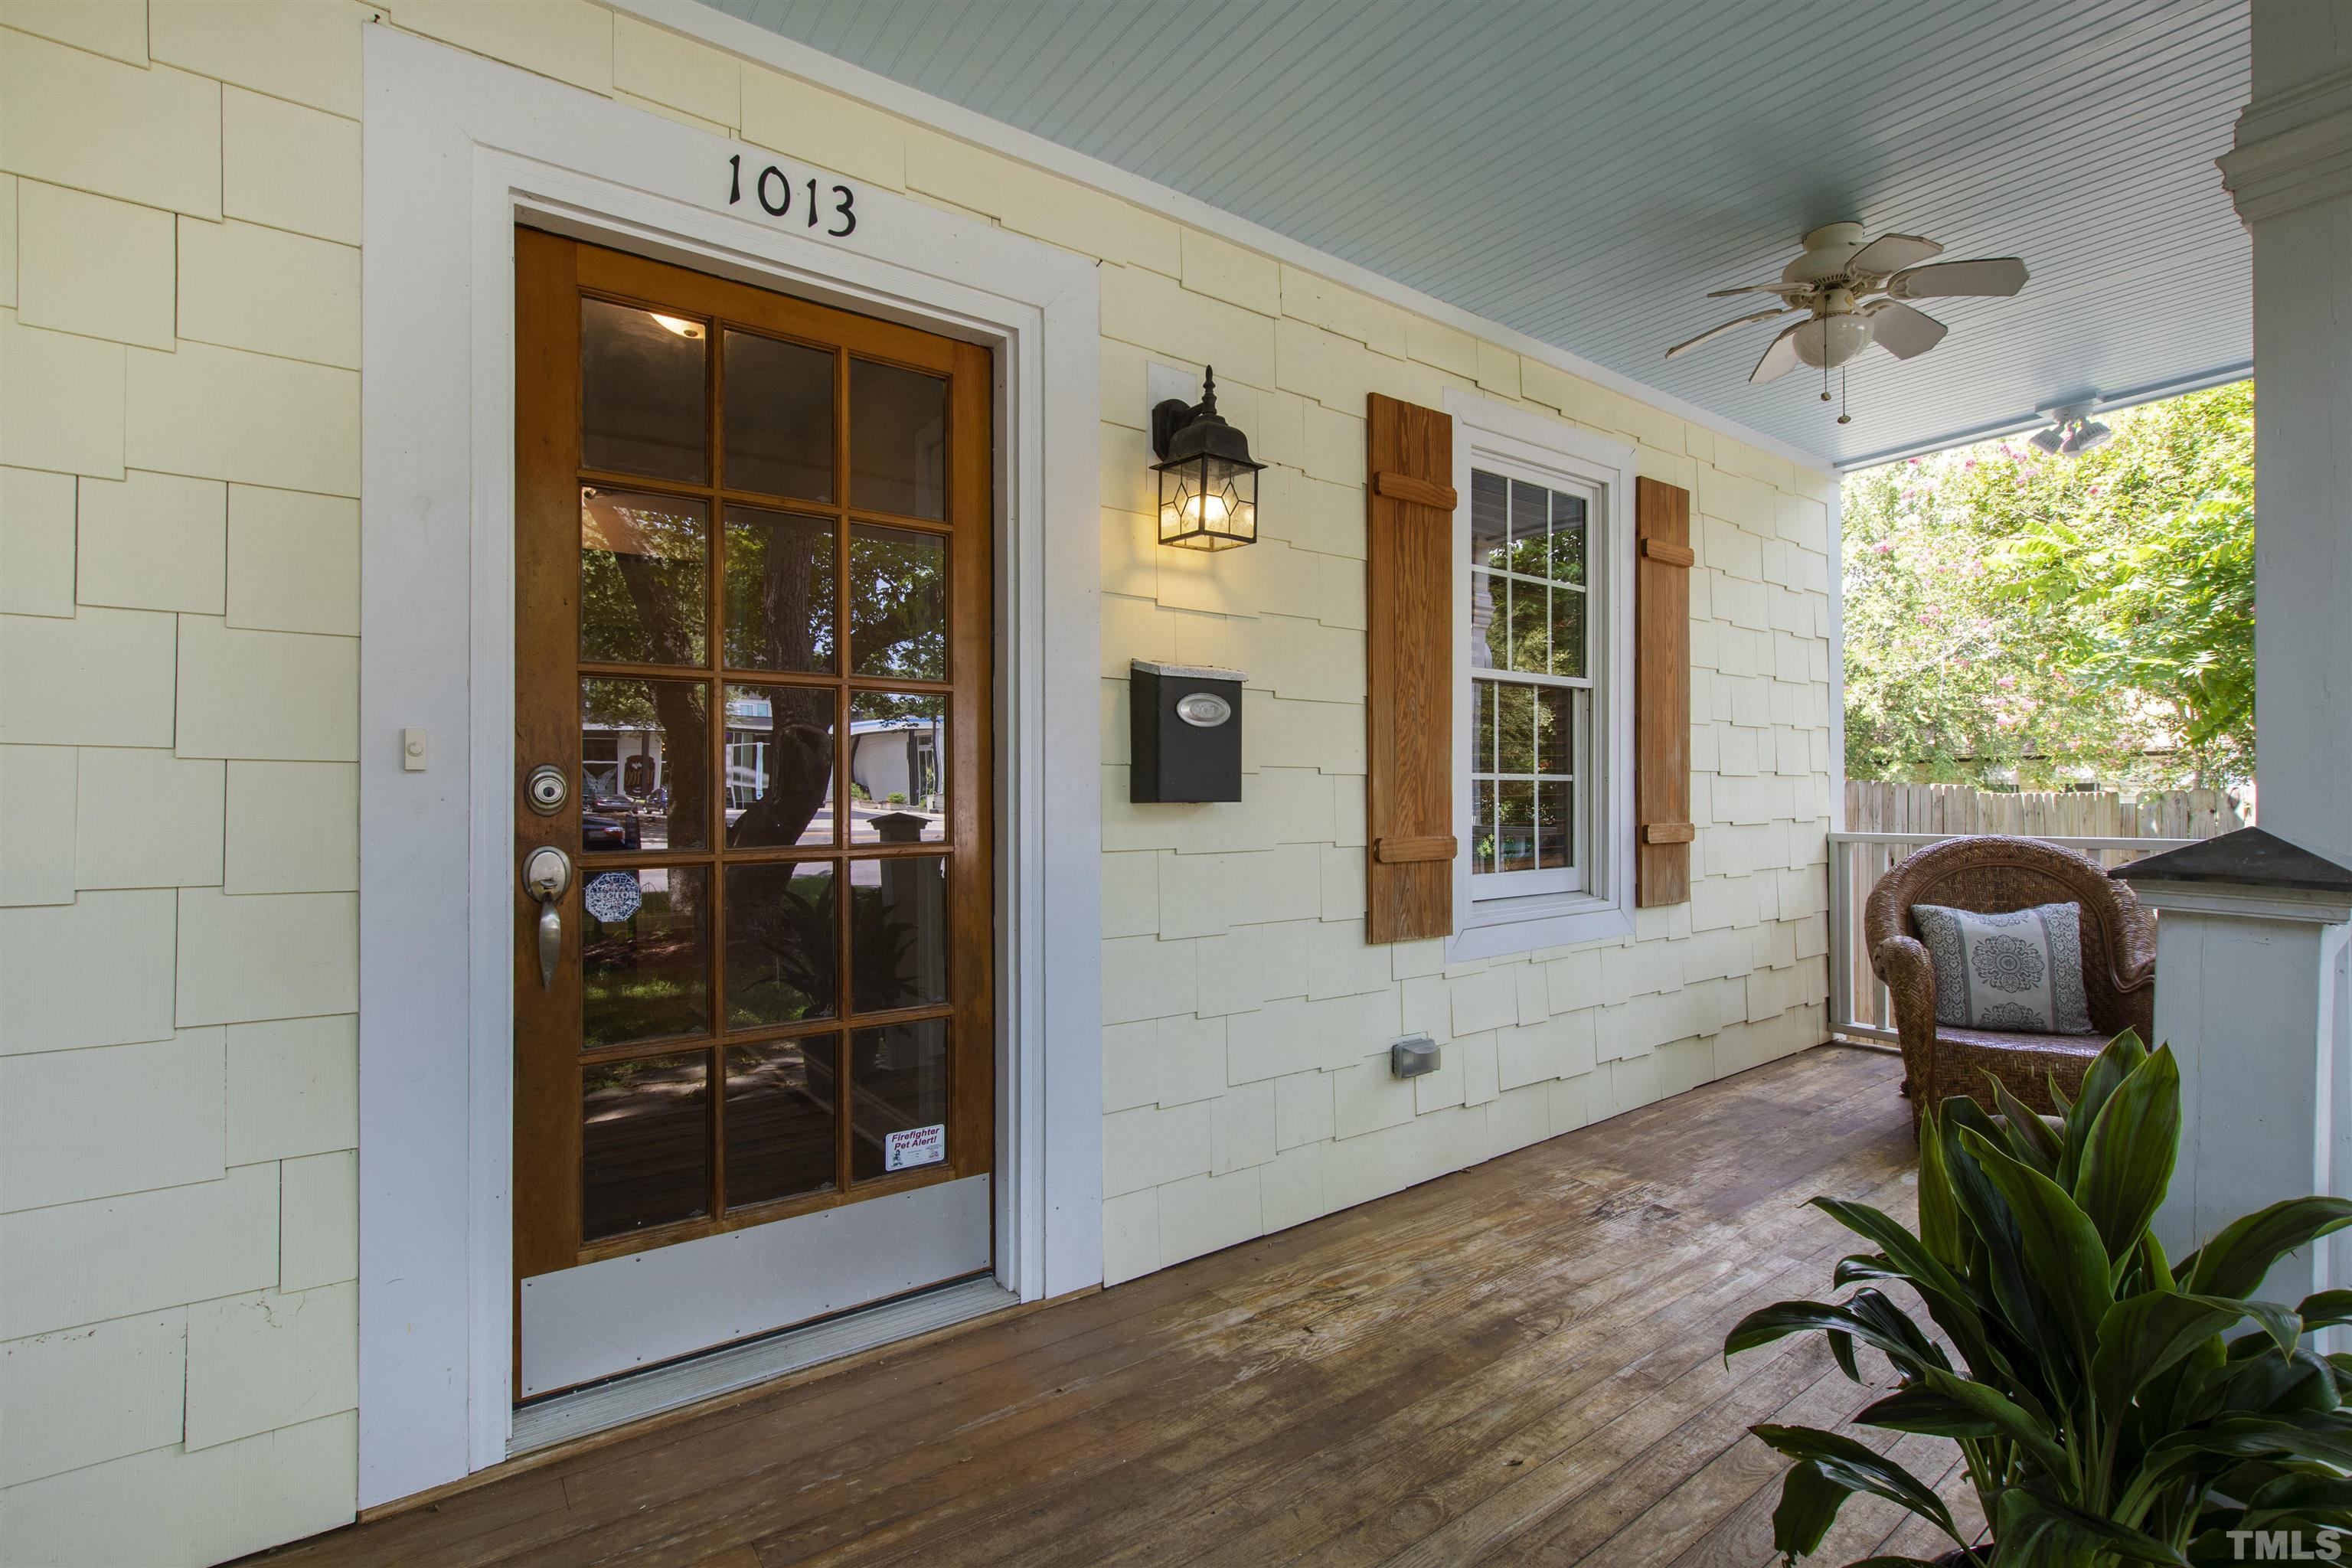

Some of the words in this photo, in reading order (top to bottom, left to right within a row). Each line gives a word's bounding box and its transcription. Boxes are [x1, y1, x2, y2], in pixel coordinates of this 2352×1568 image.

[730, 155, 856, 237] 1013
[892, 1128, 939, 1142] Firefighter
[894, 1141, 909, 1150] Pet
[911, 1136, 936, 1147] Alert!
